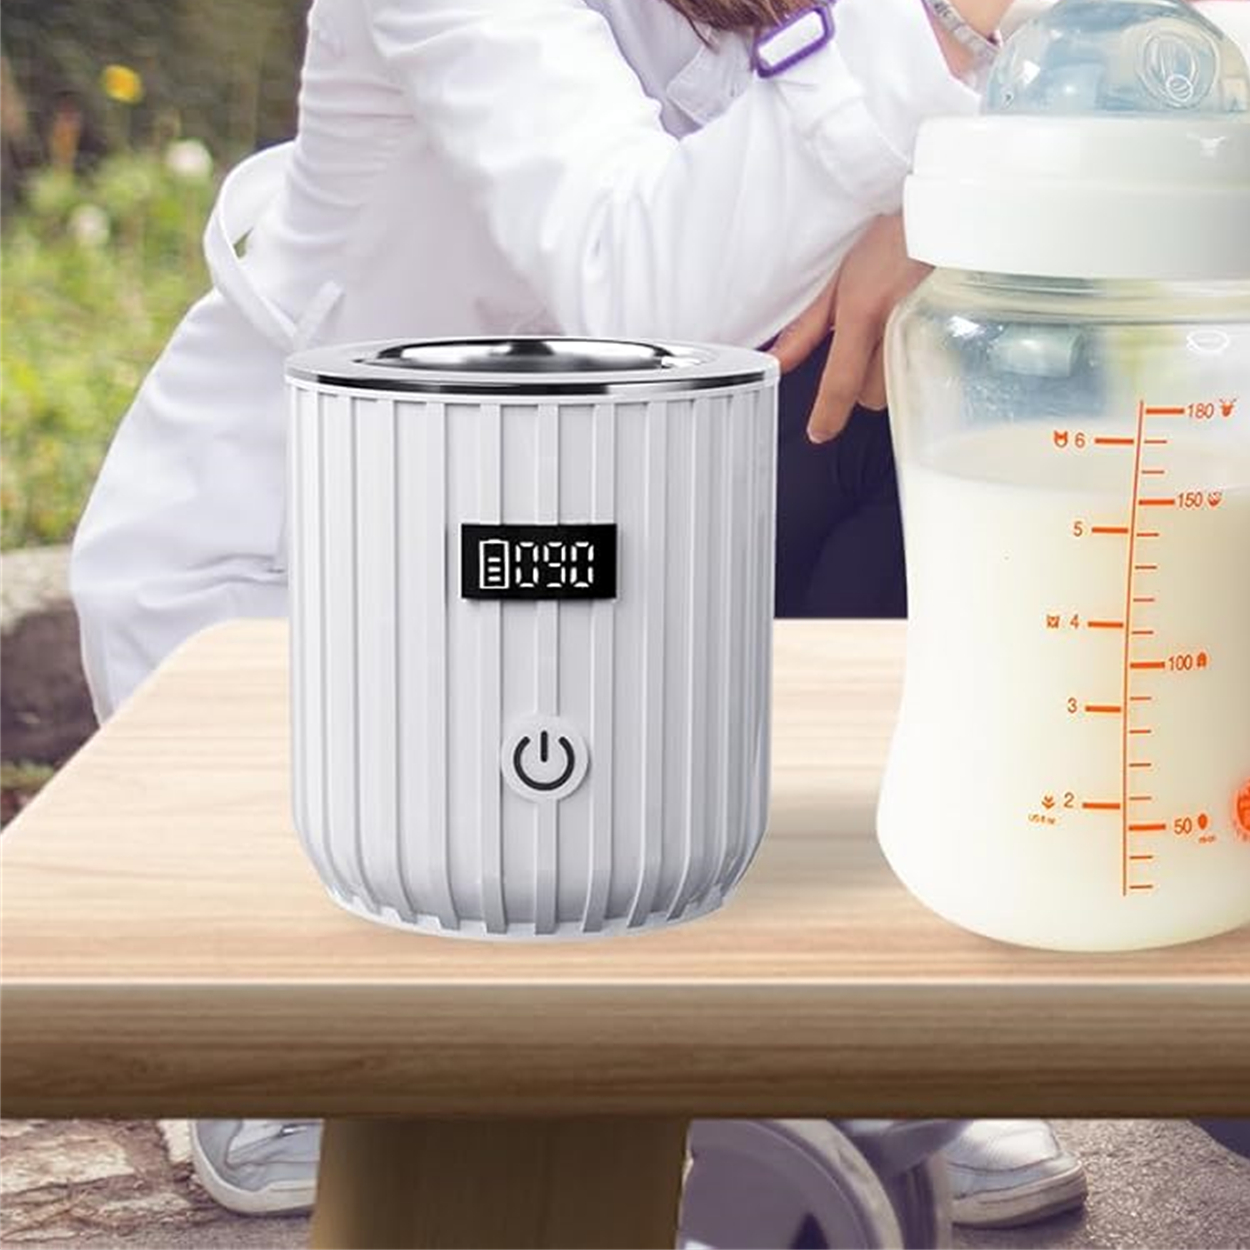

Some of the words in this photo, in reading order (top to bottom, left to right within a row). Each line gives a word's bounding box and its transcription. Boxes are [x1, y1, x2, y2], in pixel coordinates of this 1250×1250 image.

[1187, 403, 1214, 419] 180
[1074, 432, 1086, 448] 6
[1177, 491, 1203, 508] 150
[1073, 520, 1083, 537] 5
[515, 541, 594, 588] 090
[1070, 614, 1080, 628] 4
[1168, 654, 1193, 671] 100
[1067, 697, 1078, 713] 3
[1063, 791, 1075, 809] 2
[1174, 817, 1193, 835] 50
